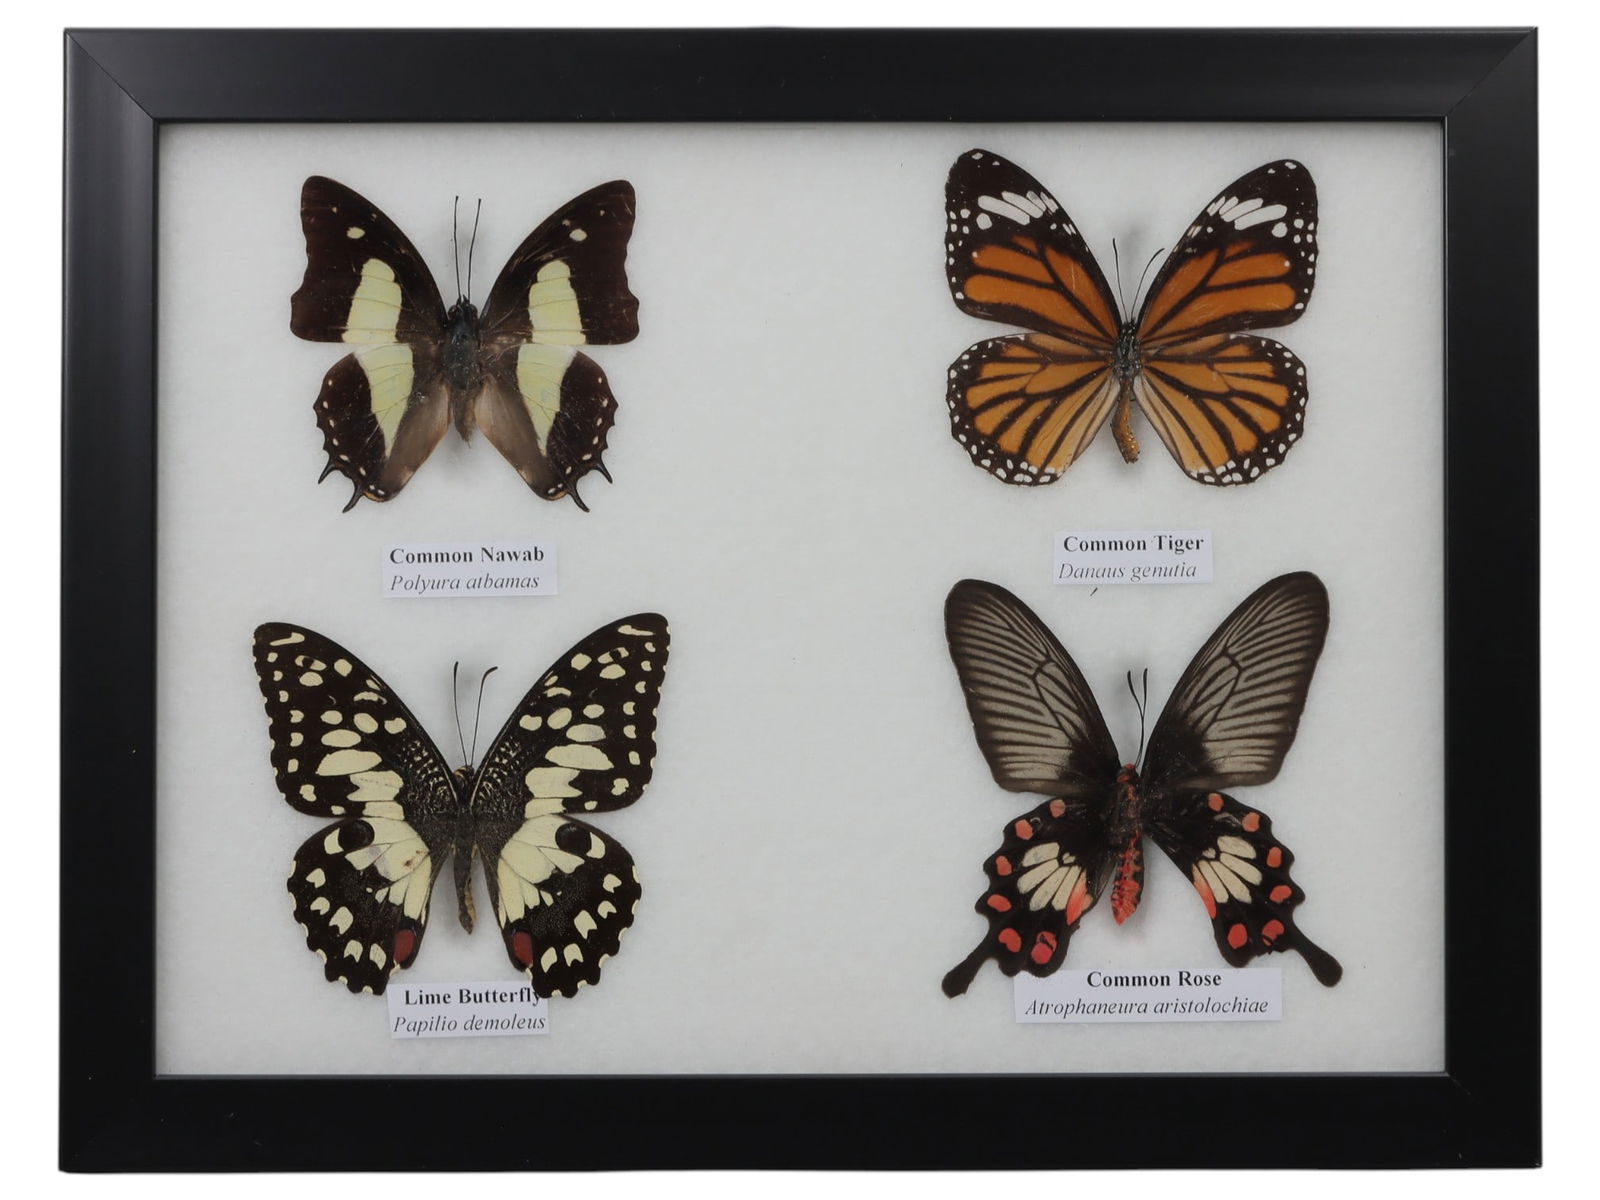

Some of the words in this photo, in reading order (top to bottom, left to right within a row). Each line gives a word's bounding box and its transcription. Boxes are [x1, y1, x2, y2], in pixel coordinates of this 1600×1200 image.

[389, 548, 473, 564] Common
[481, 546, 544, 562] Nawab
[1063, 536, 1147, 552] Common
[1153, 535, 1204, 555] Tiger
[1059, 563, 1126, 579] Danaus
[1130, 562, 1197, 583] genutia
[390, 574, 460, 595] Polyura
[1087, 971, 1170, 987] Common
[1178, 970, 1222, 986] Rose
[405, 990, 451, 1005] Lime
[1025, 999, 1148, 1019] Atrophaneura
[1153, 997, 1268, 1014] aristolochiae
[394, 1015, 458, 1036] Papilio
[463, 1013, 546, 1031] demoleus
